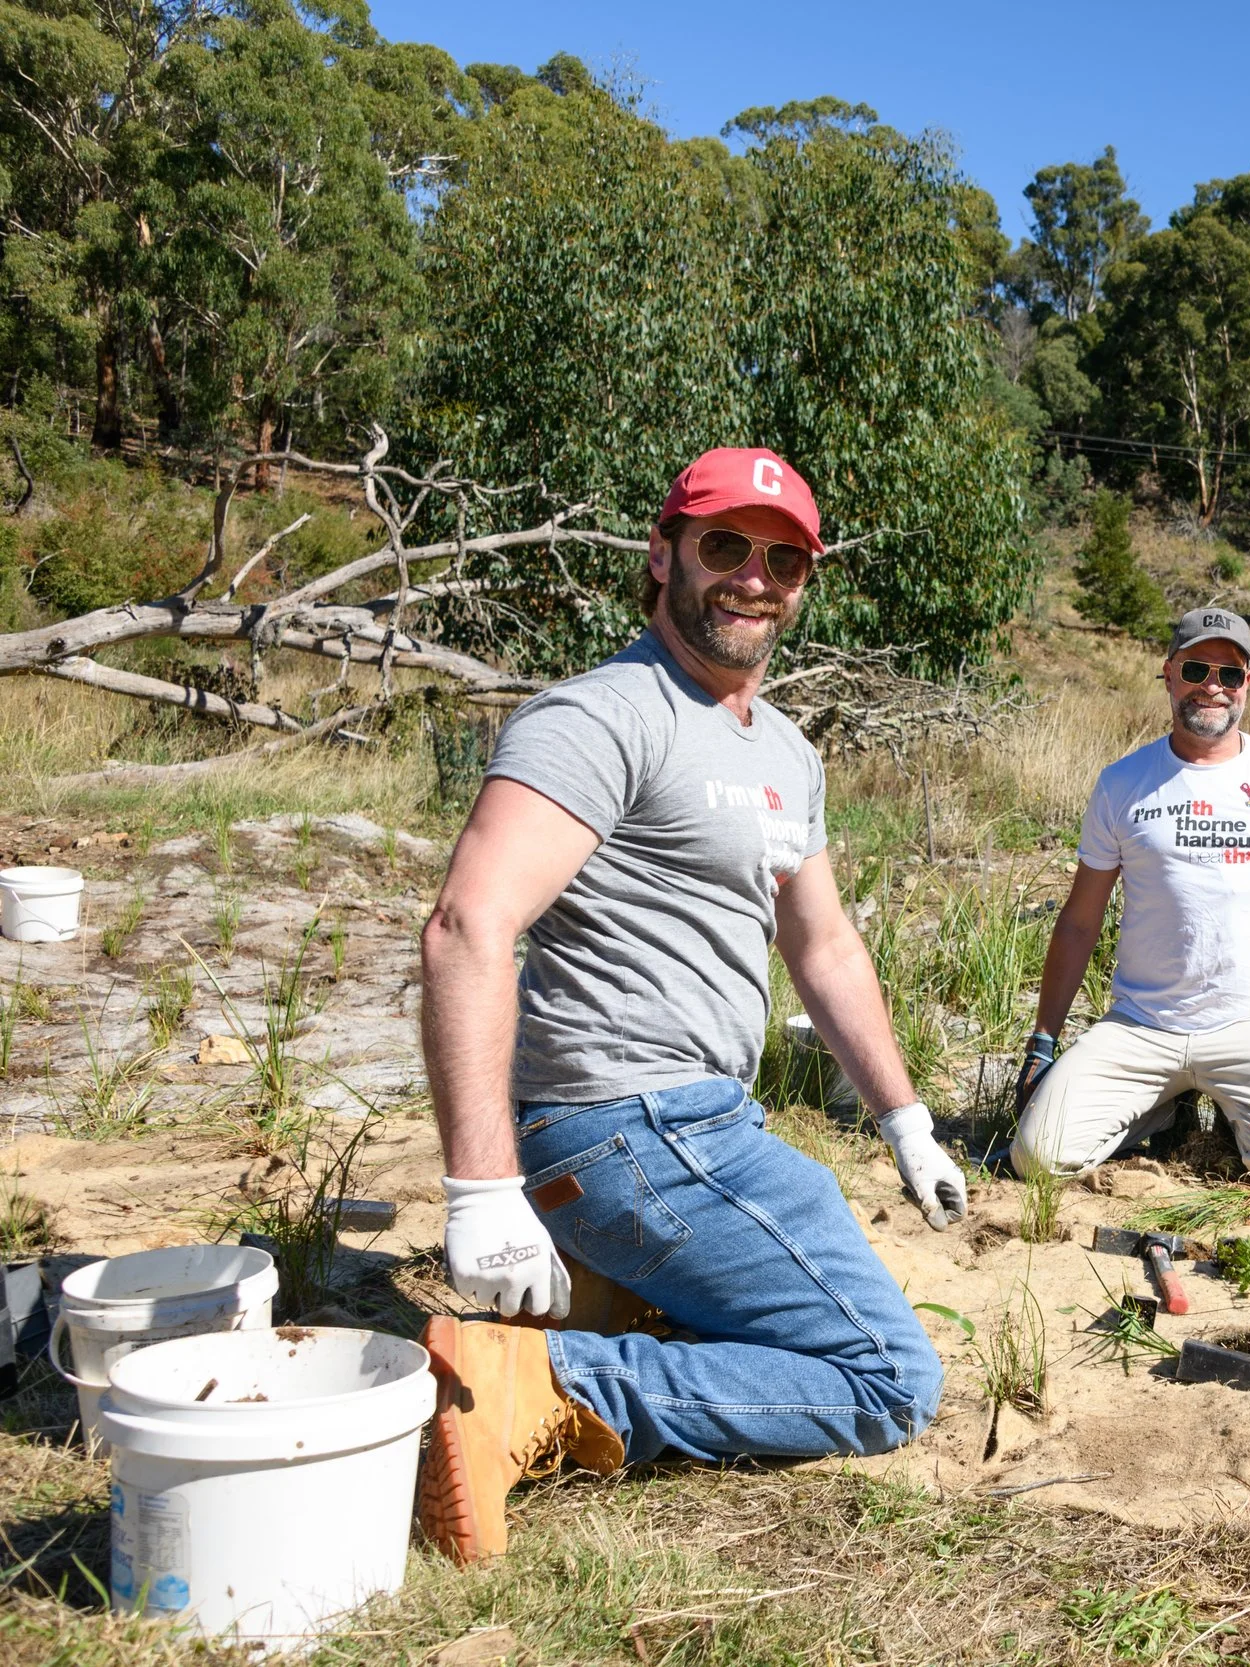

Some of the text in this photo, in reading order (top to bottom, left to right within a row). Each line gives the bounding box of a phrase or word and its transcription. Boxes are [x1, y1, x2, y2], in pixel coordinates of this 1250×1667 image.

[752, 457, 784, 496] C
[1203, 614, 1231, 630] CAT
[705, 780, 749, 809] I'm
[1133, 800, 1213, 823] I'm with
[1175, 816, 1247, 832] thorne
[1189, 848, 1246, 864] health
[479, 1245, 538, 1269] SAXON
